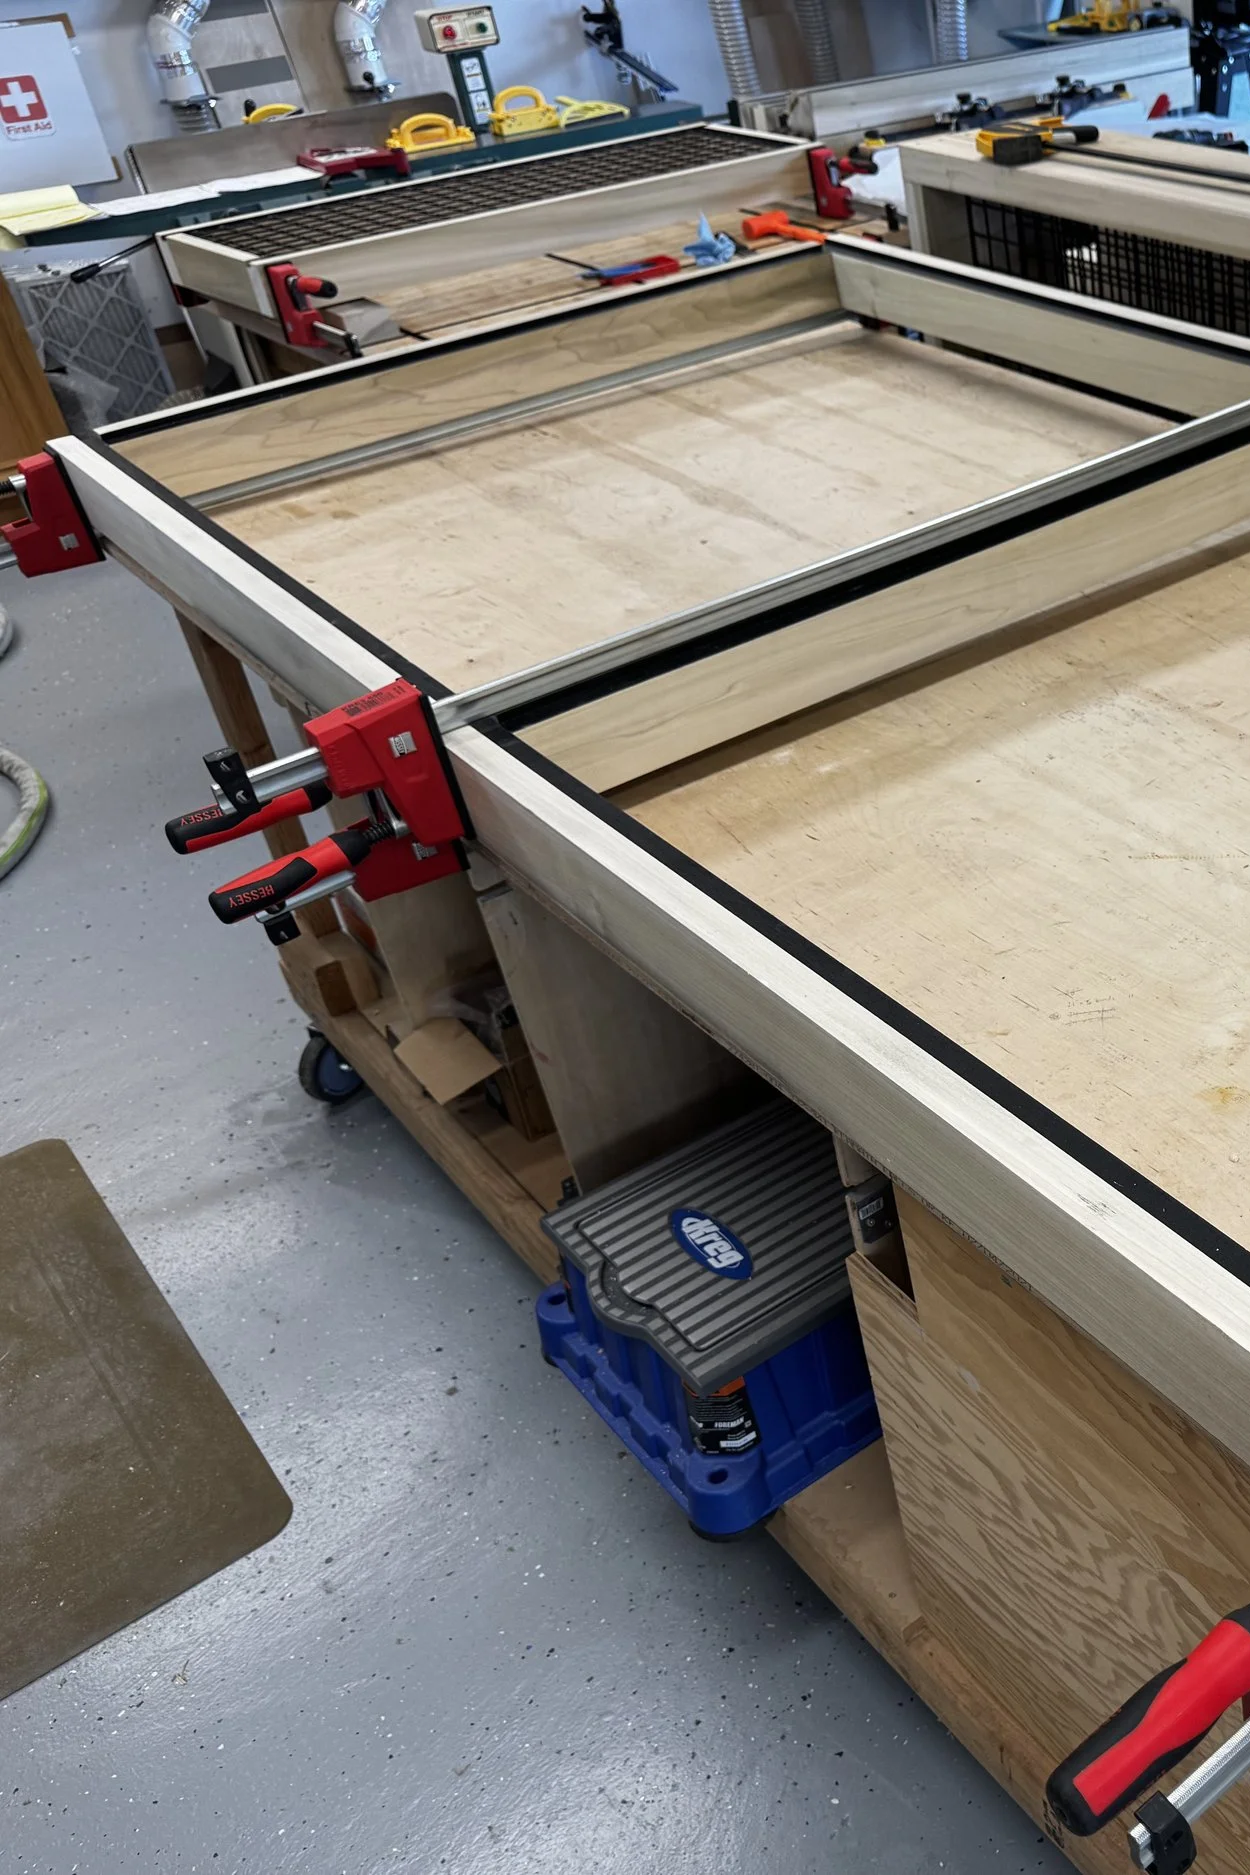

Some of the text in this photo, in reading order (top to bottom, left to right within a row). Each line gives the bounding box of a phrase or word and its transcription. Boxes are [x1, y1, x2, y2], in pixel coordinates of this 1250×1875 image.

[6, 120, 52, 135] First Aid
[229, 884, 275, 908] BESSEY
[681, 1217, 744, 1269] Kreg
